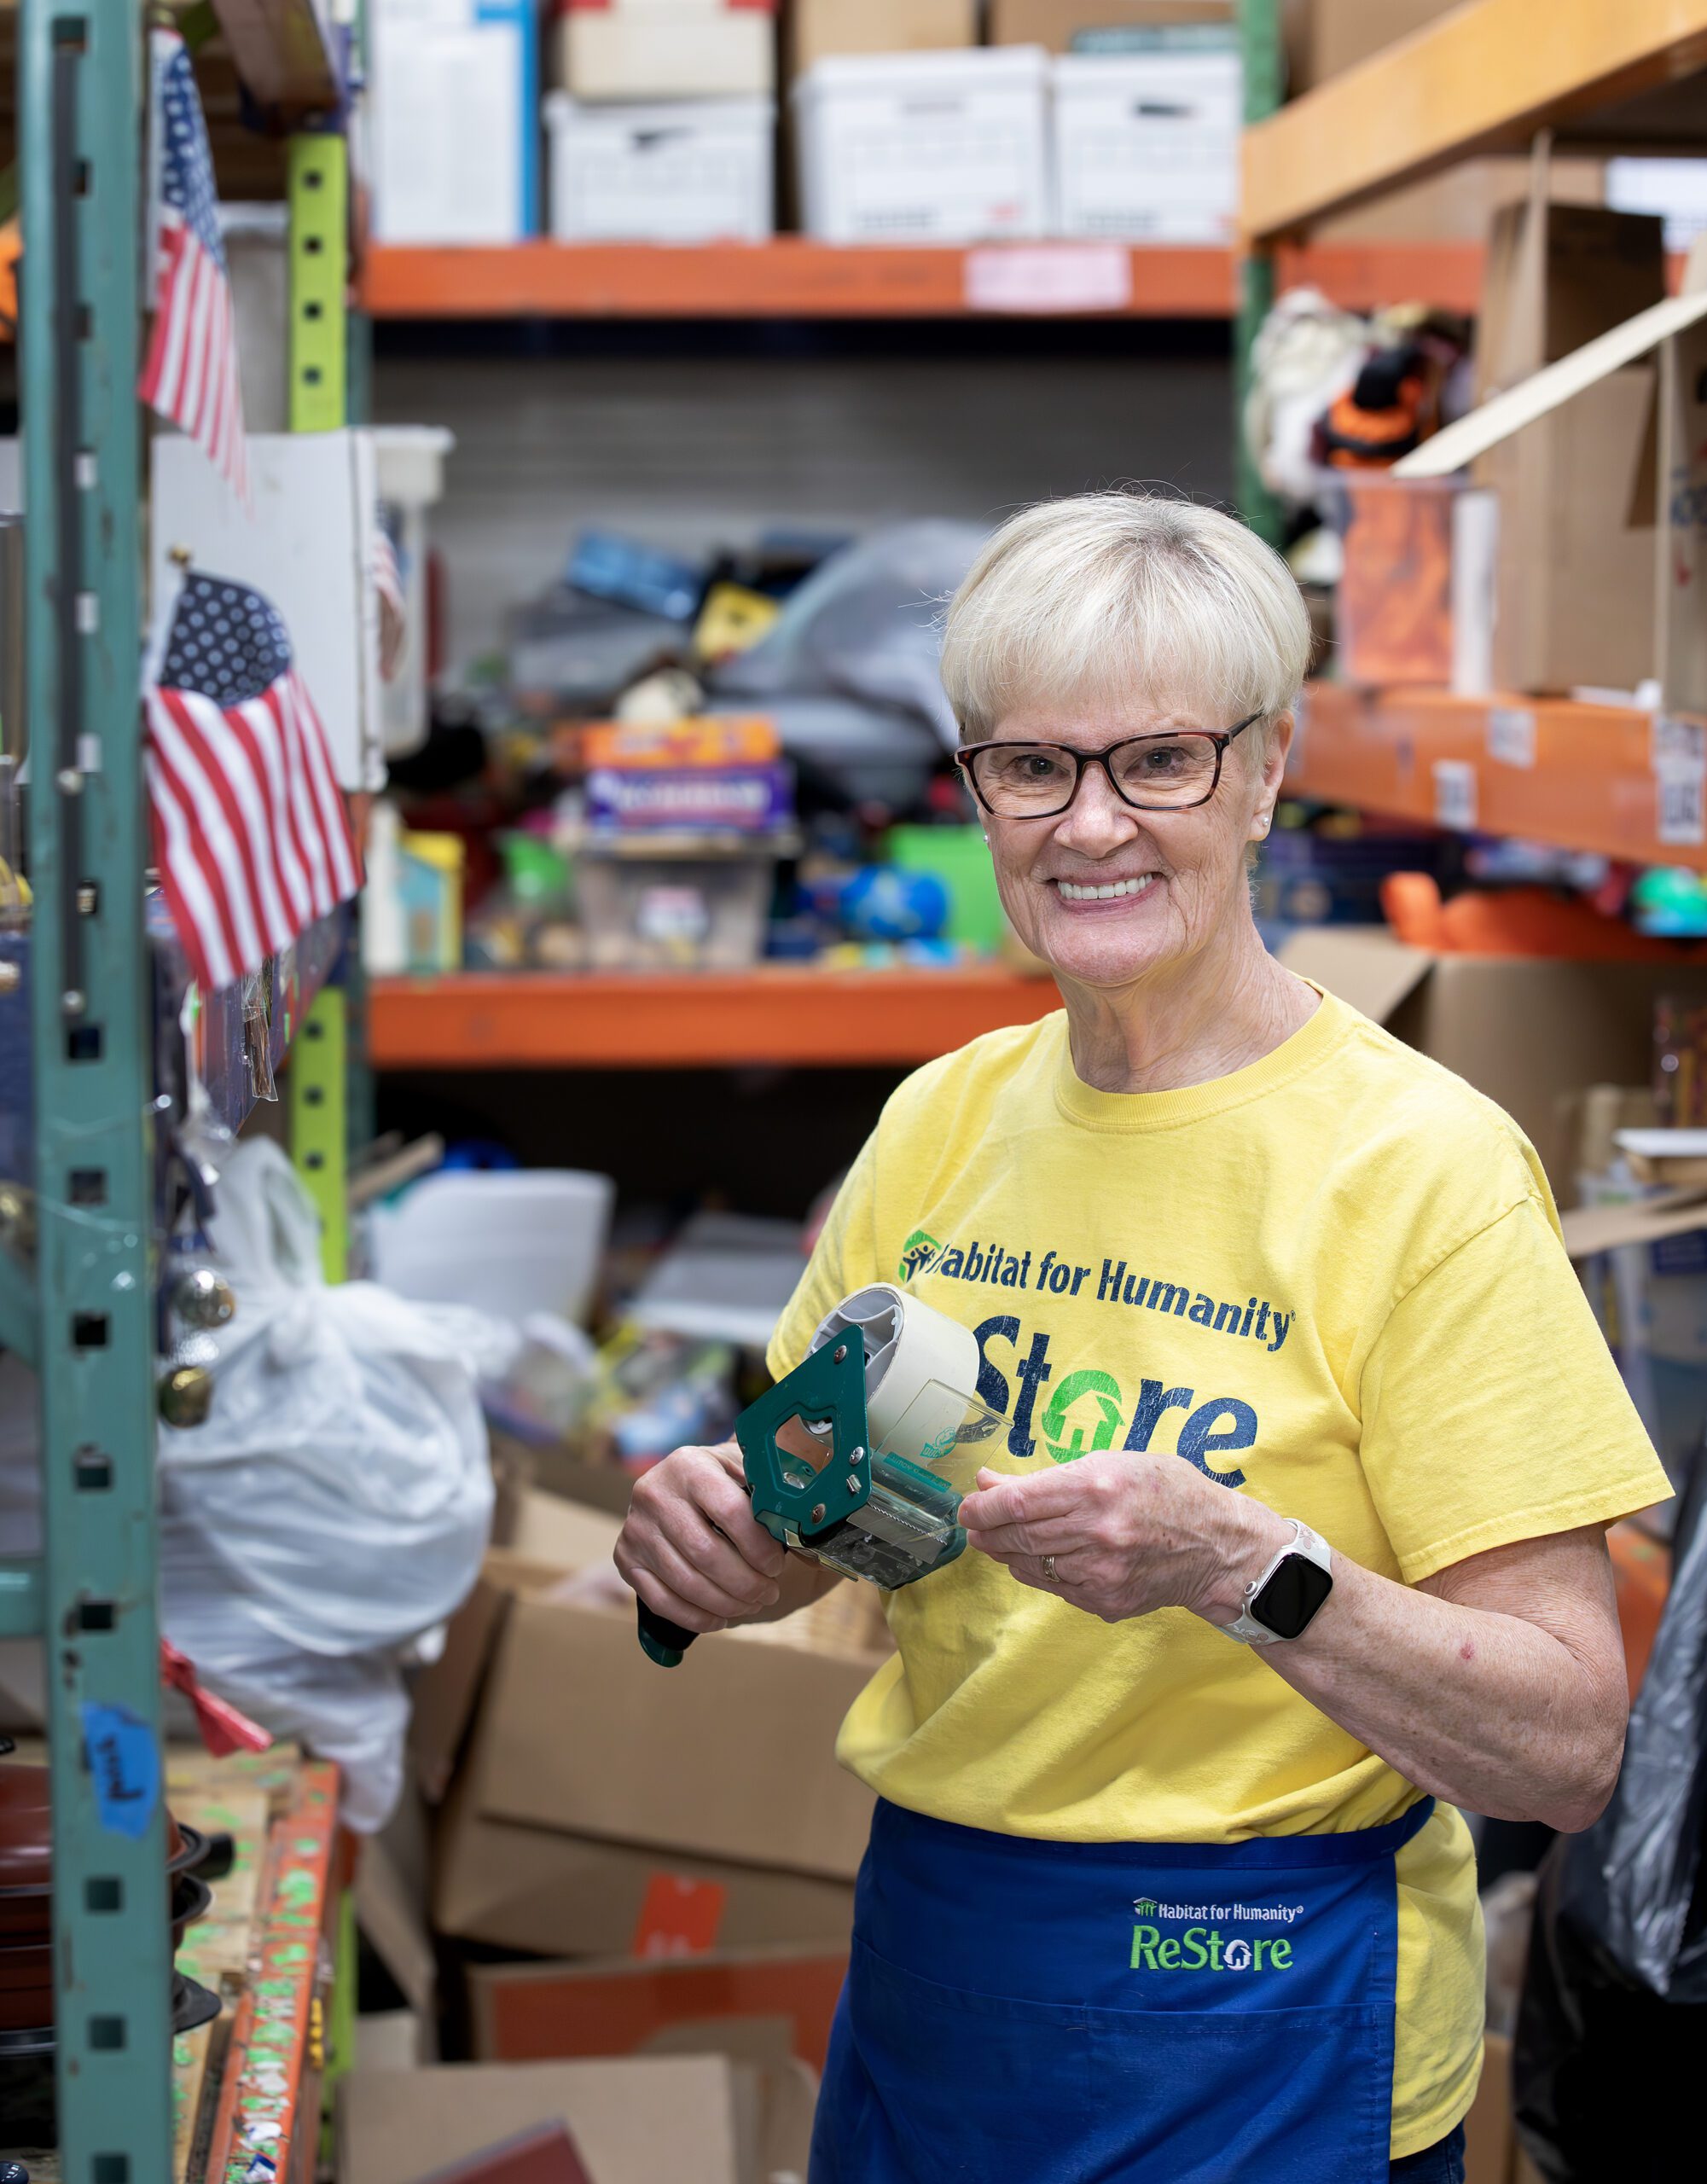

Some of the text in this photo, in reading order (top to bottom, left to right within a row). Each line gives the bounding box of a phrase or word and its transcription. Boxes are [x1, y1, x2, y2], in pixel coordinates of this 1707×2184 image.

[1036, 1251, 1091, 1296] for
[1158, 1903, 1208, 1920] Habitat
[1210, 1903, 1232, 1920] for
[1129, 1925, 1293, 1972] ReStore
